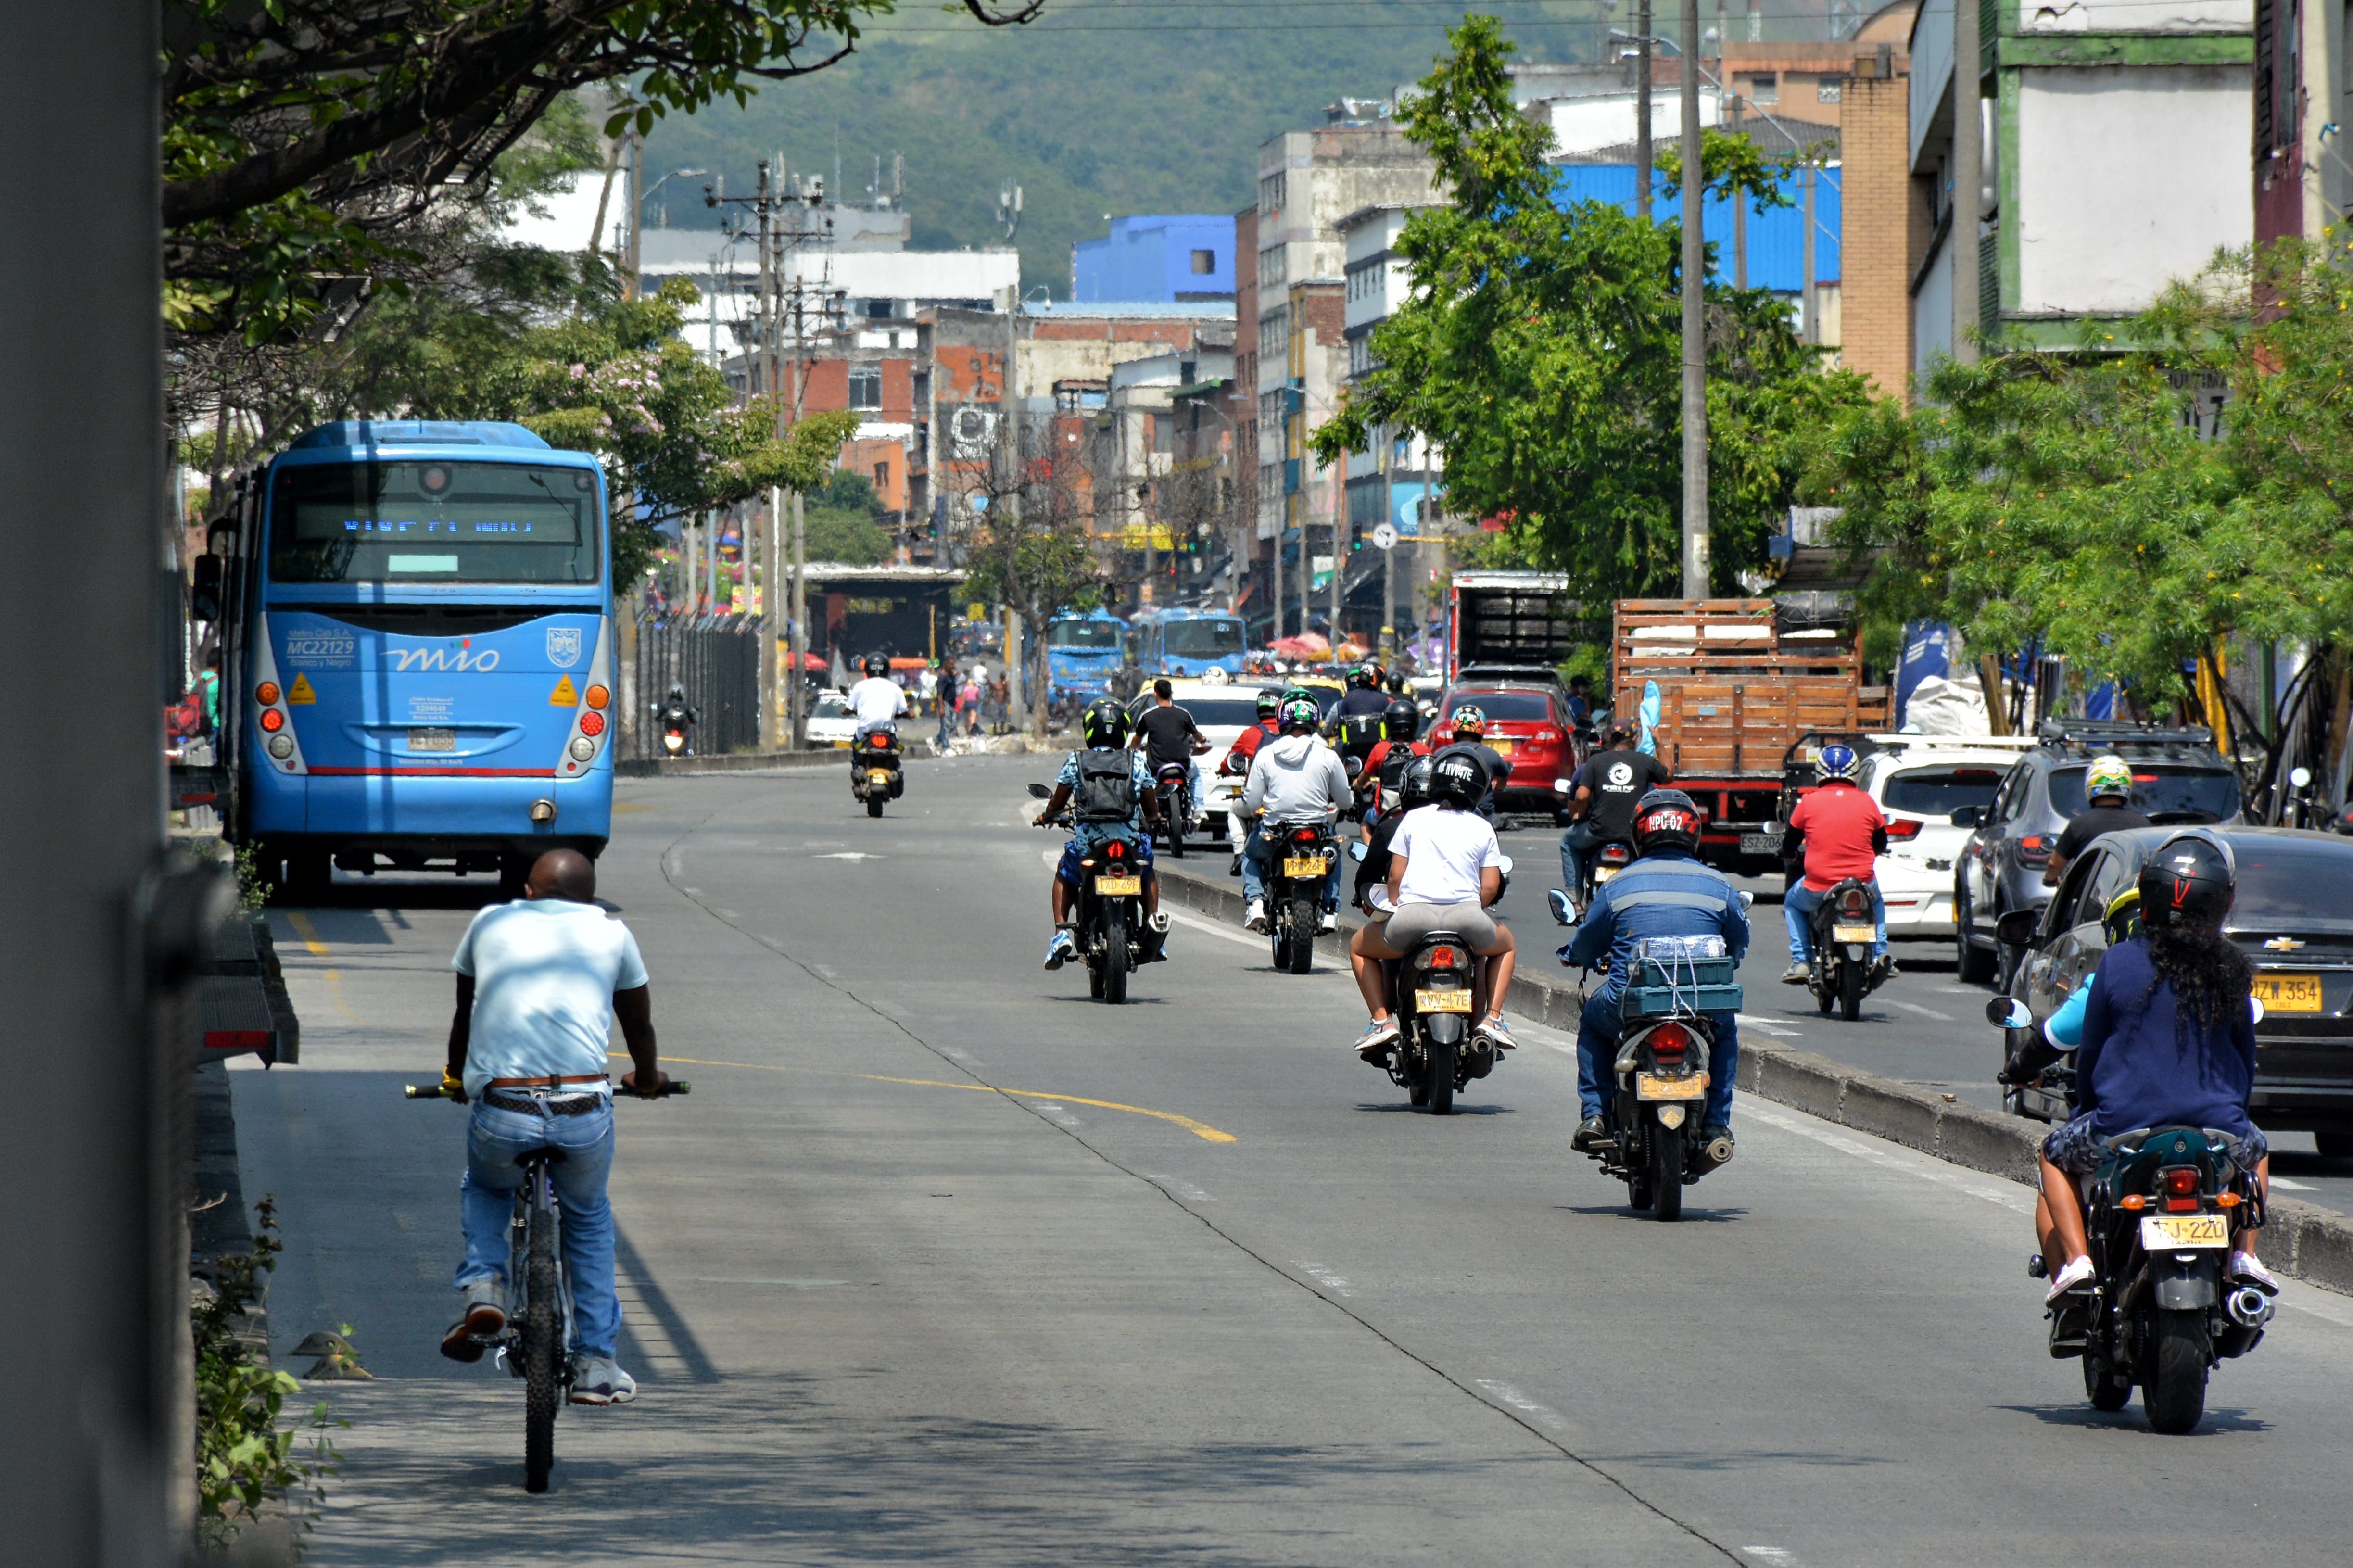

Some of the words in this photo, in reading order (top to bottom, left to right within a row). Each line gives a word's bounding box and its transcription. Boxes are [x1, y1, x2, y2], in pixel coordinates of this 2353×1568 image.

[287, 640, 354, 654] MC22129
[327, 658, 351, 668] Negro
[380, 645, 500, 672] mio
[2286, 981, 2317, 1001] 354
